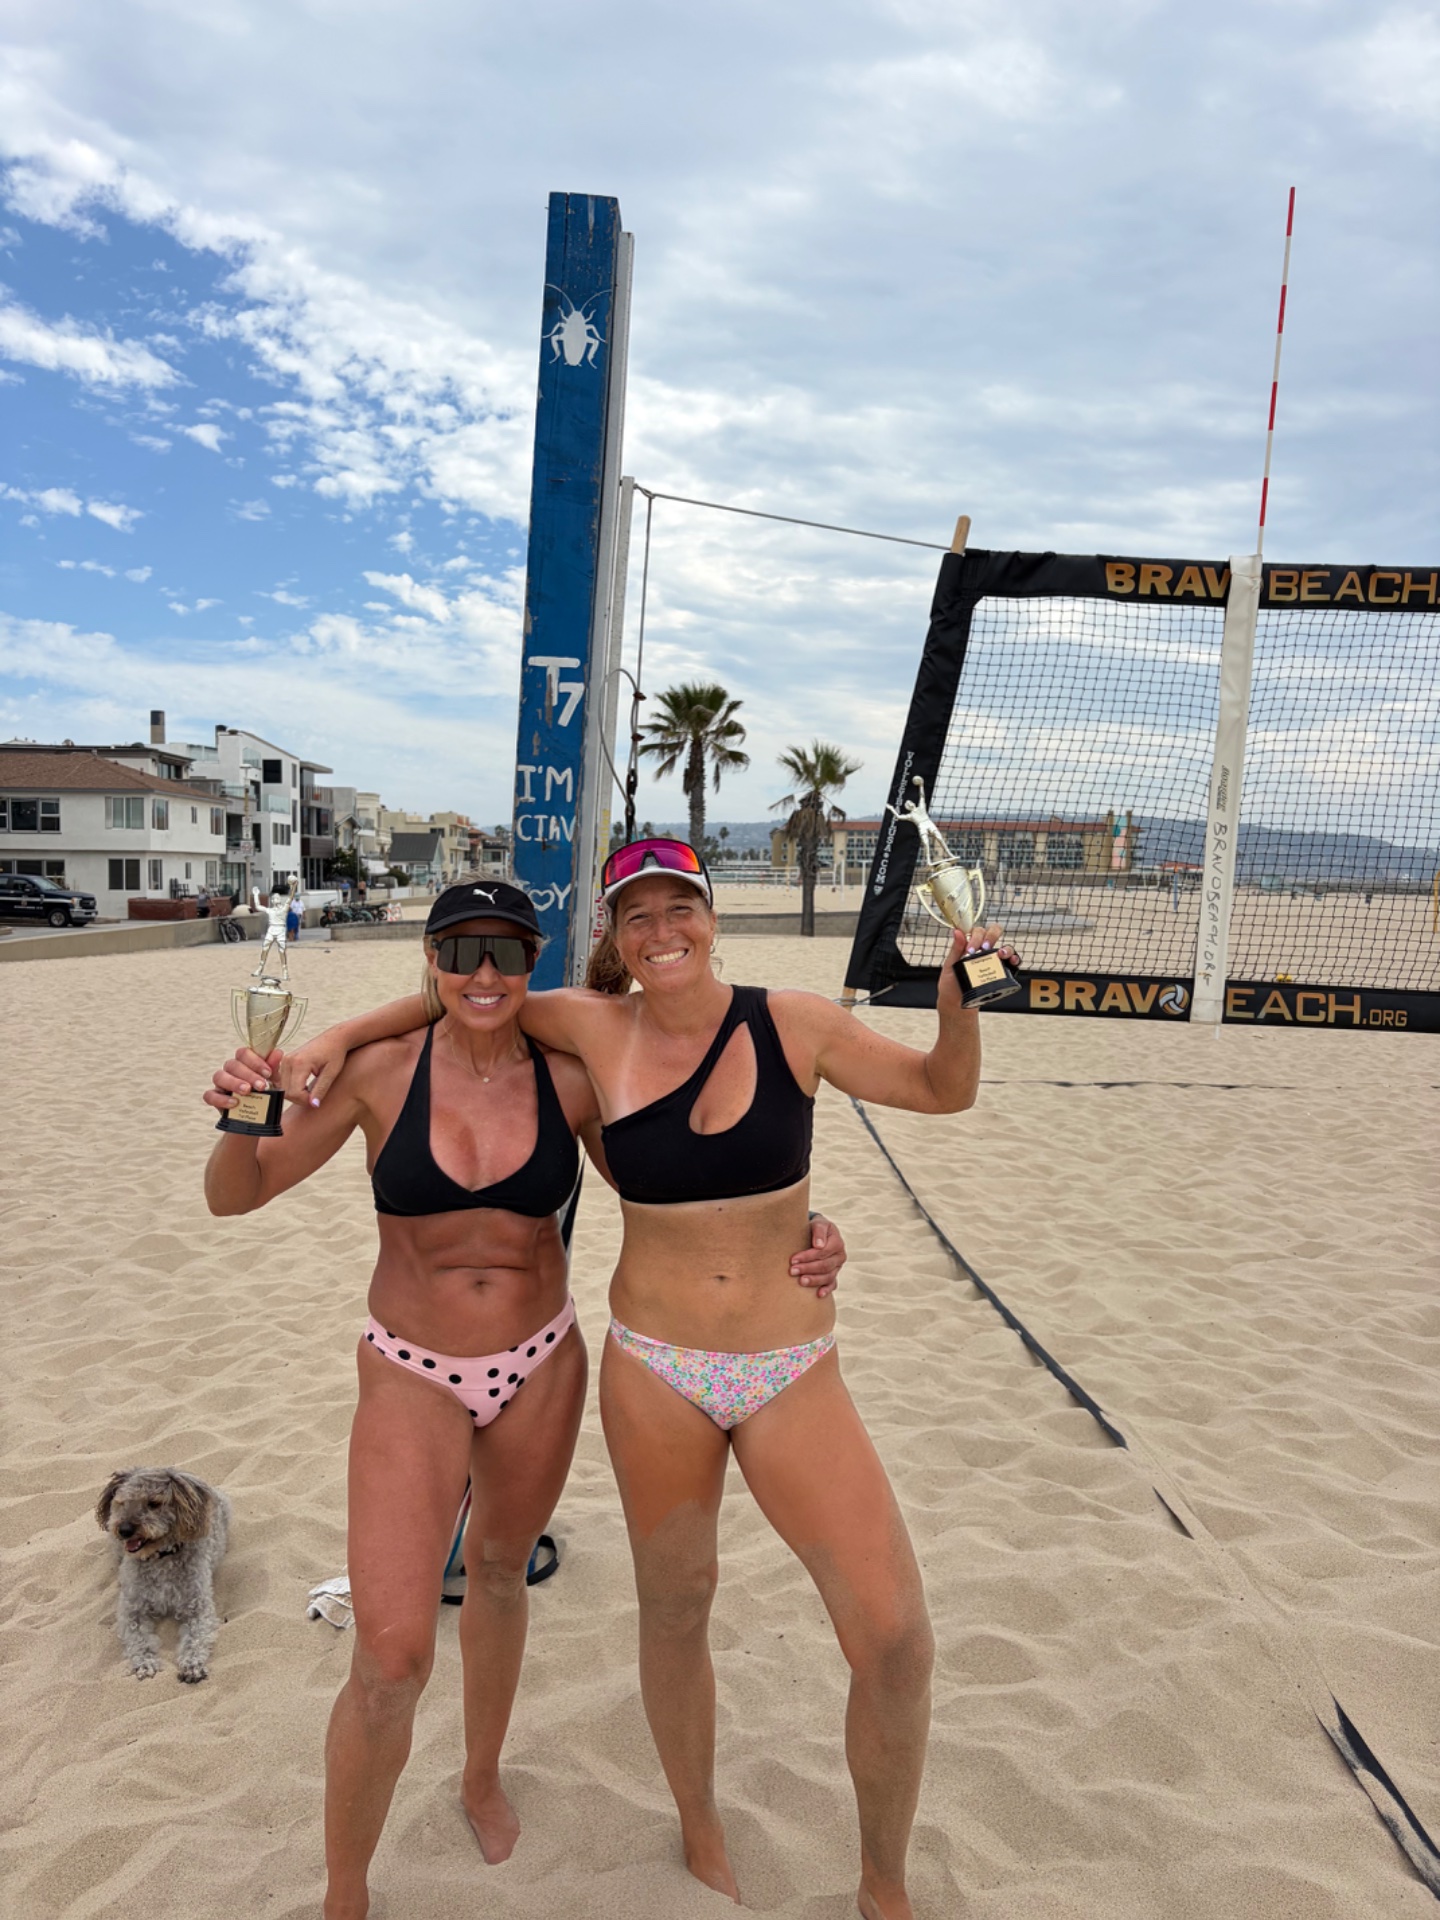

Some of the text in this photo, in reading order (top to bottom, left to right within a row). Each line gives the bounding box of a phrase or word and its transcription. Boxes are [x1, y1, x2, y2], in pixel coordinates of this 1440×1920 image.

[527, 656, 586, 728] T7
[517, 765, 574, 803] I'M
[1224, 987, 1408, 1028] EACH.ORG
